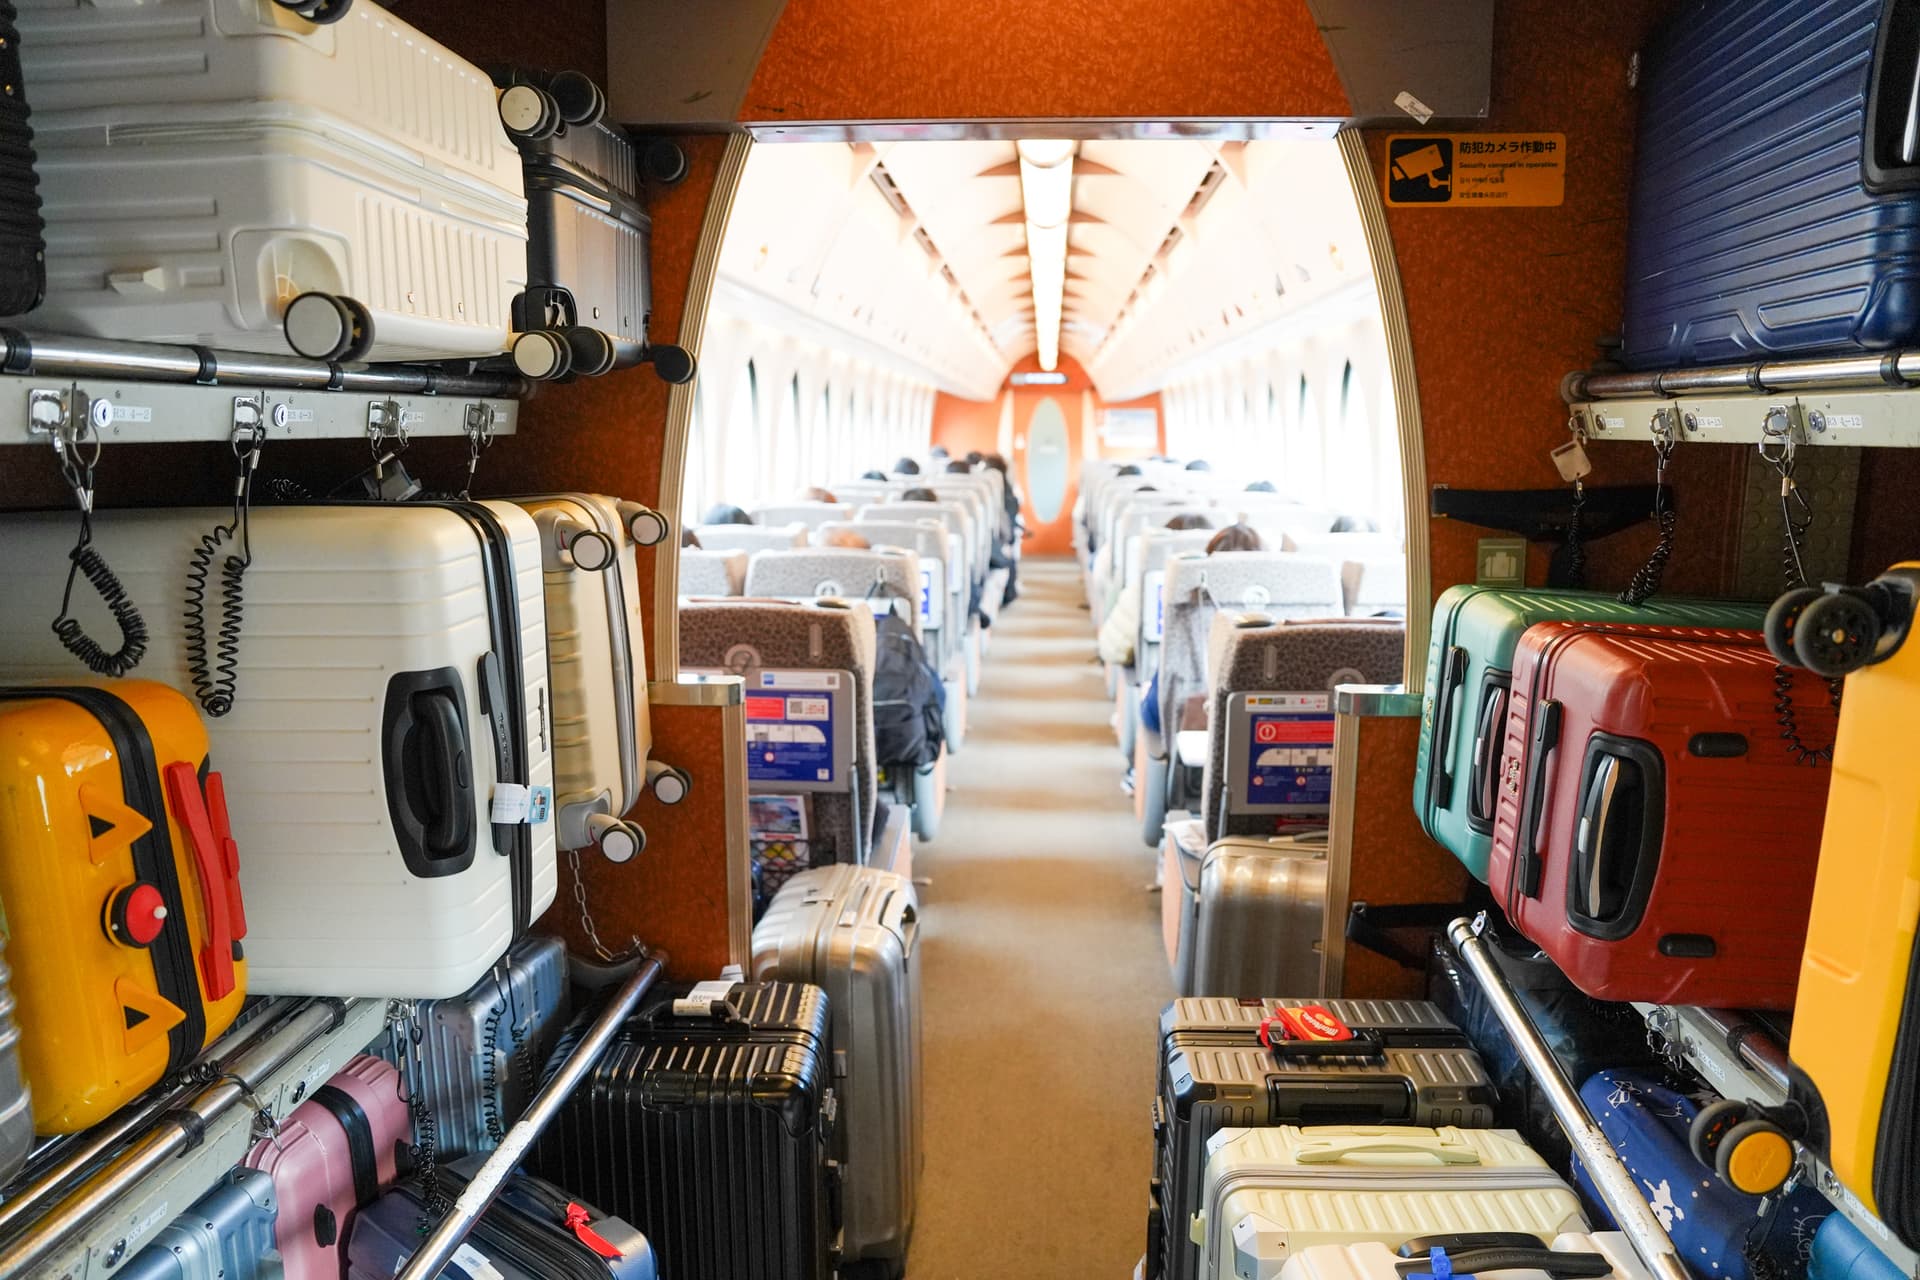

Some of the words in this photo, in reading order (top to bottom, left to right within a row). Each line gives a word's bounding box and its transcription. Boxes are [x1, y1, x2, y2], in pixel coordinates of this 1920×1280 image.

[1459, 141, 1557, 155] 防犯カメラ作動中
[1459, 161, 1486, 169] Security
